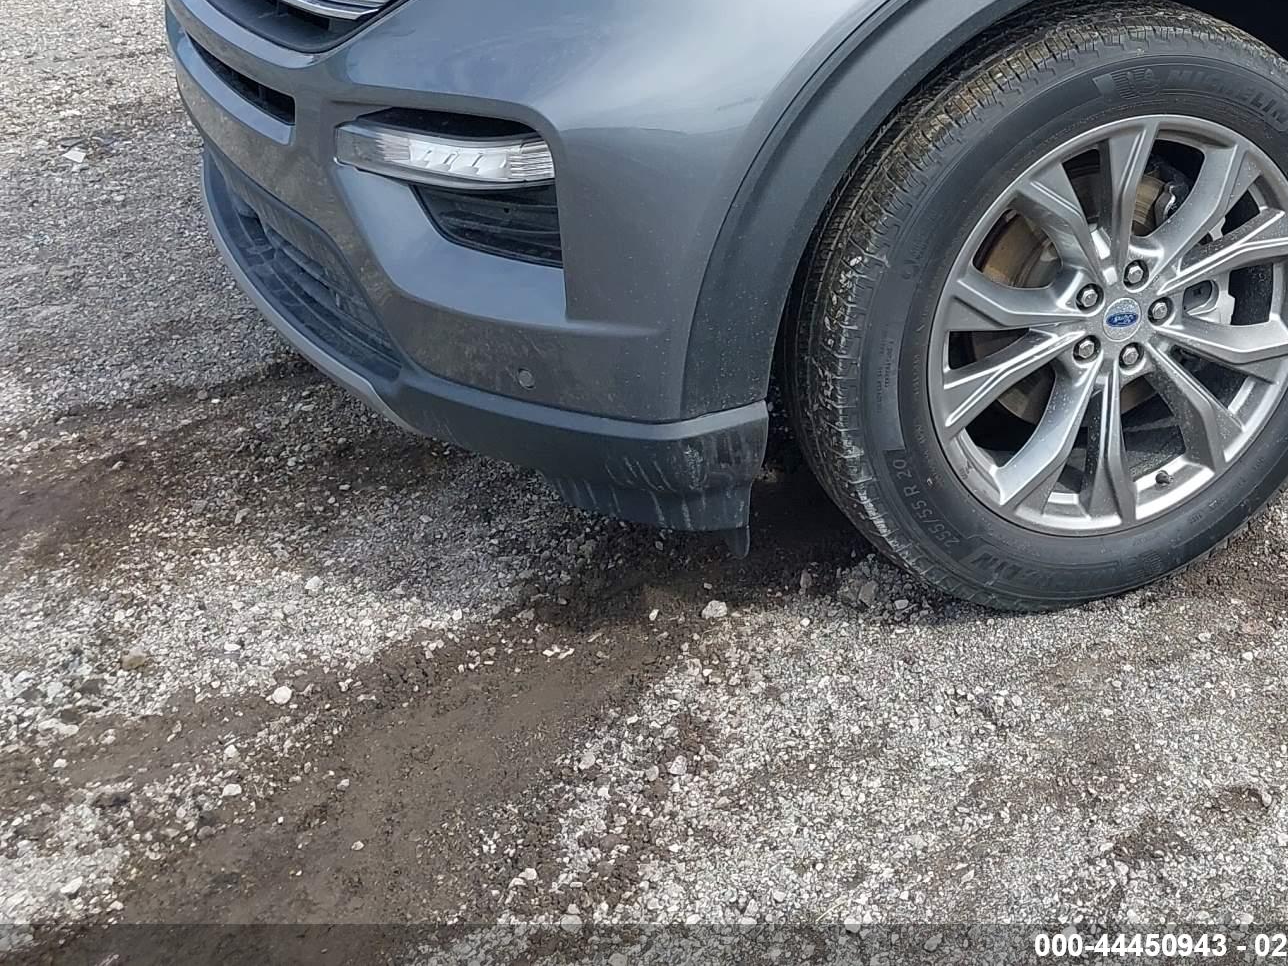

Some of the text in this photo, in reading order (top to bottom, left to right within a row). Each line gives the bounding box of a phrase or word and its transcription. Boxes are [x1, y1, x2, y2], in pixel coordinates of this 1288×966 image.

[891, 458, 914, 480] 20
[903, 483, 922, 499] R
[911, 499, 961, 548] 255/55
